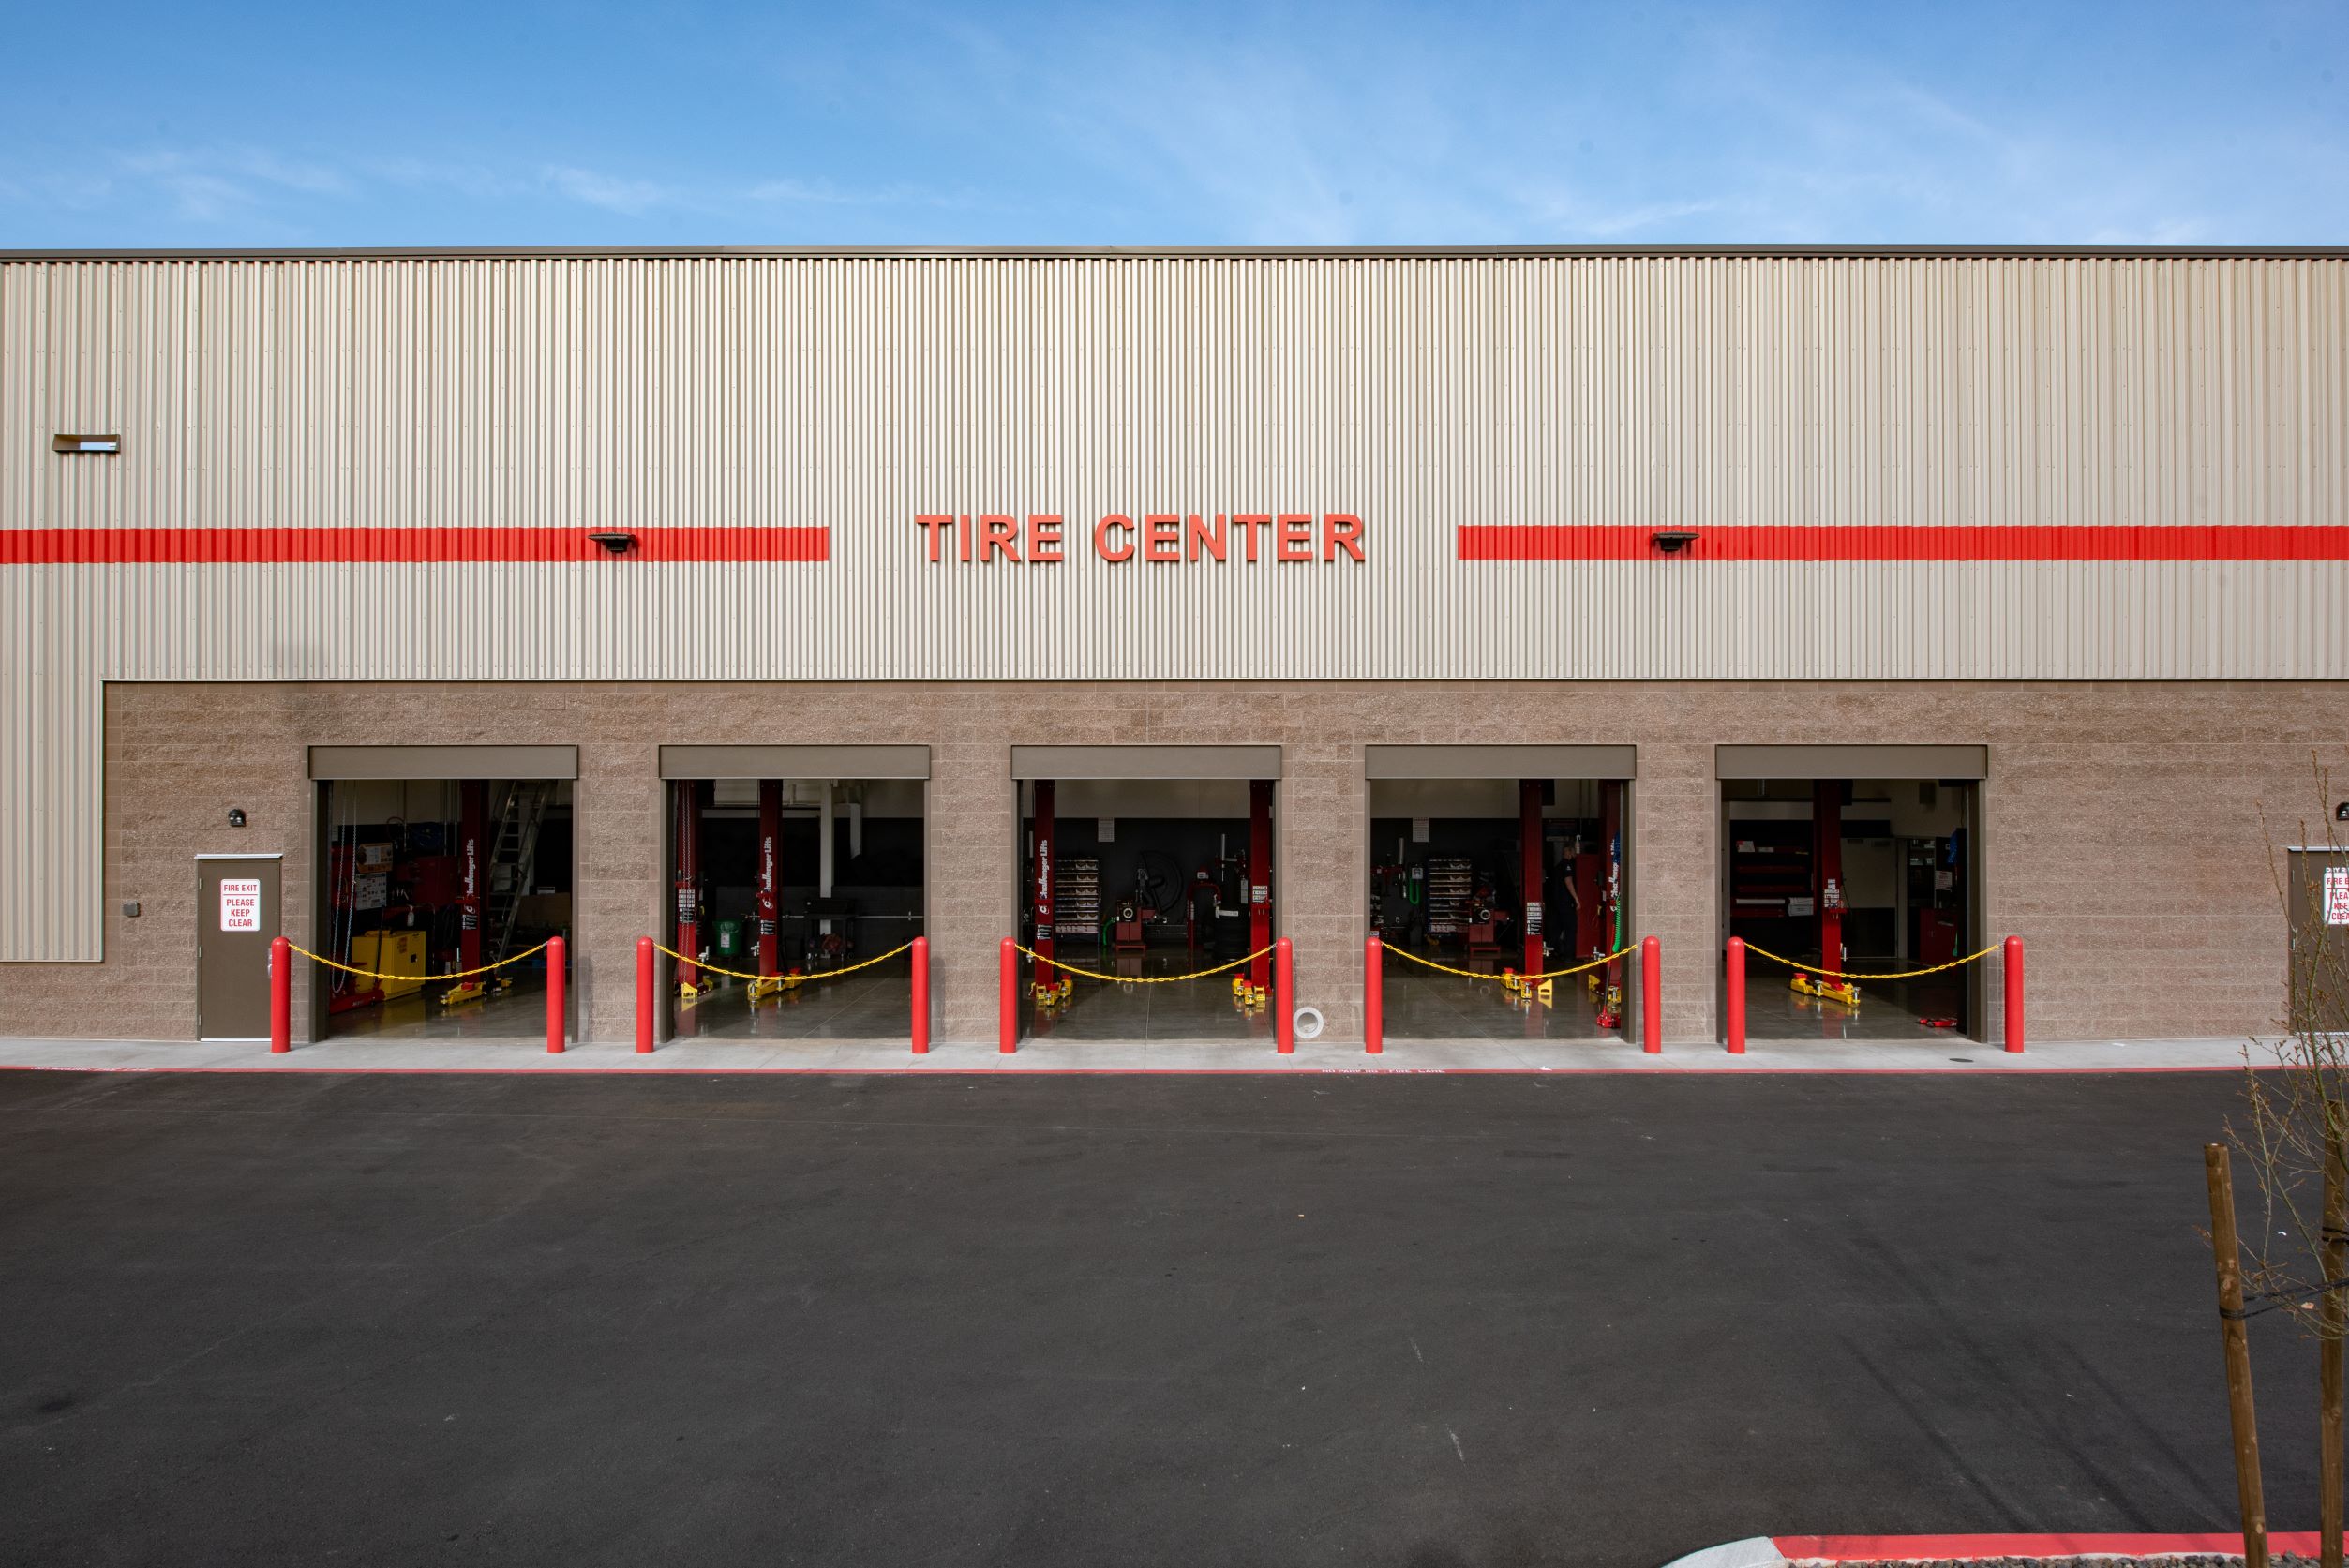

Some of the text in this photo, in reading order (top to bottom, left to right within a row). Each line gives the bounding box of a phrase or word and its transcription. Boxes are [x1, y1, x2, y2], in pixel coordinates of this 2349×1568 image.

[916, 514, 1365, 562] TIRE CENTER
[228, 918, 252, 927] CLEAR
